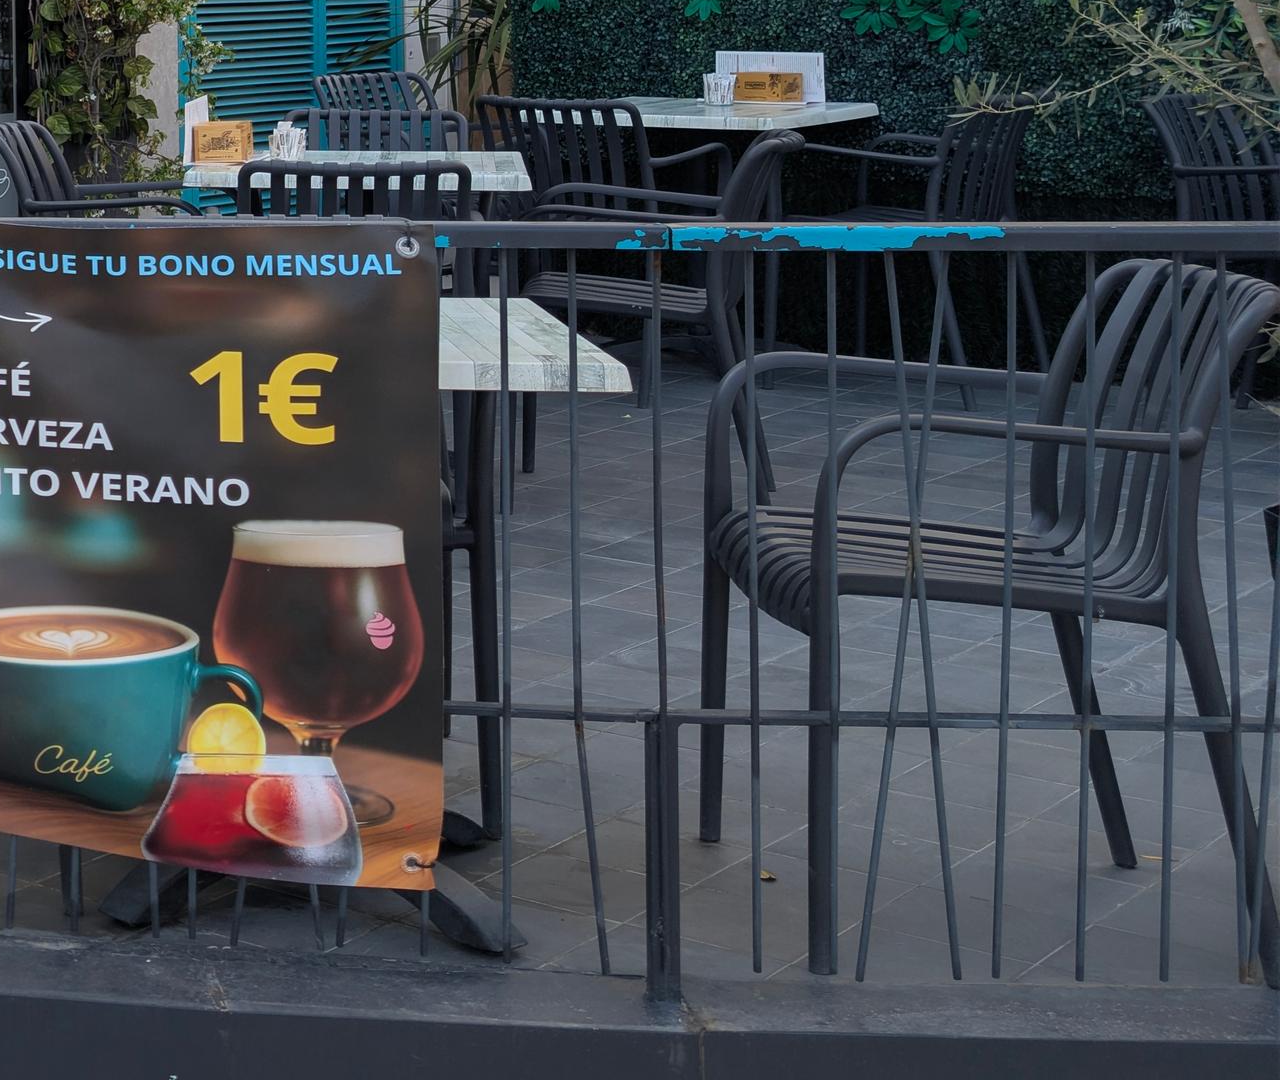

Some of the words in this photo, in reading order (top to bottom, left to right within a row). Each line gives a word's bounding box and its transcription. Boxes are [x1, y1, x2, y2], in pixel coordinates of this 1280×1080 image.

[84, 253, 127, 276] TU
[137, 254, 236, 277] BONO
[245, 251, 402, 277] MENSUAL
[188, 349, 340, 446] 1€
[71, 472, 251, 507] VERANO
[33, 744, 115, 779] Café
